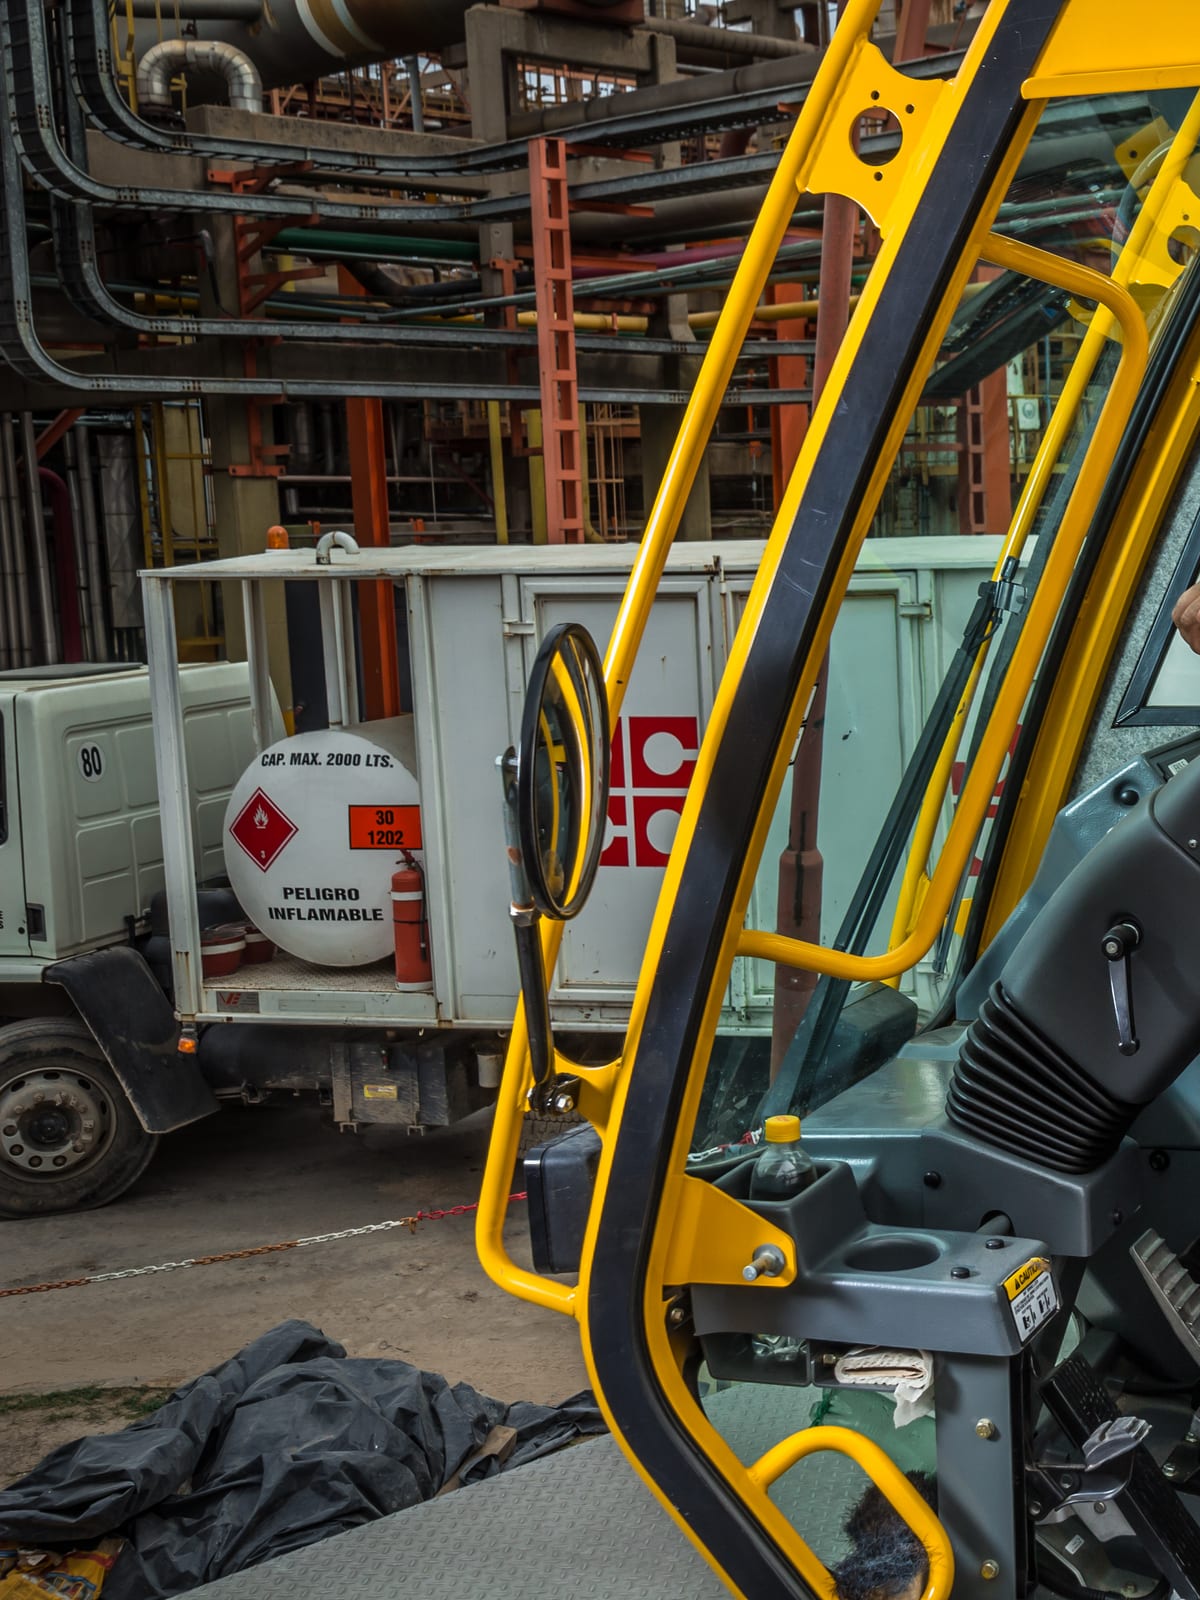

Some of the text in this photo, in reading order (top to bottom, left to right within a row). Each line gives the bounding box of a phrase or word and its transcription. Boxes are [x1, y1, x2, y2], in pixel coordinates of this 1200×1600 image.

[81, 746, 101, 777] 80
[261, 752, 394, 768] CAP. MAX. 2000 LTS.
[376, 810, 394, 825] 30
[368, 830, 404, 845] 1202
[283, 887, 360, 901] PELIGRO
[268, 907, 384, 921] INFLAMABLE
